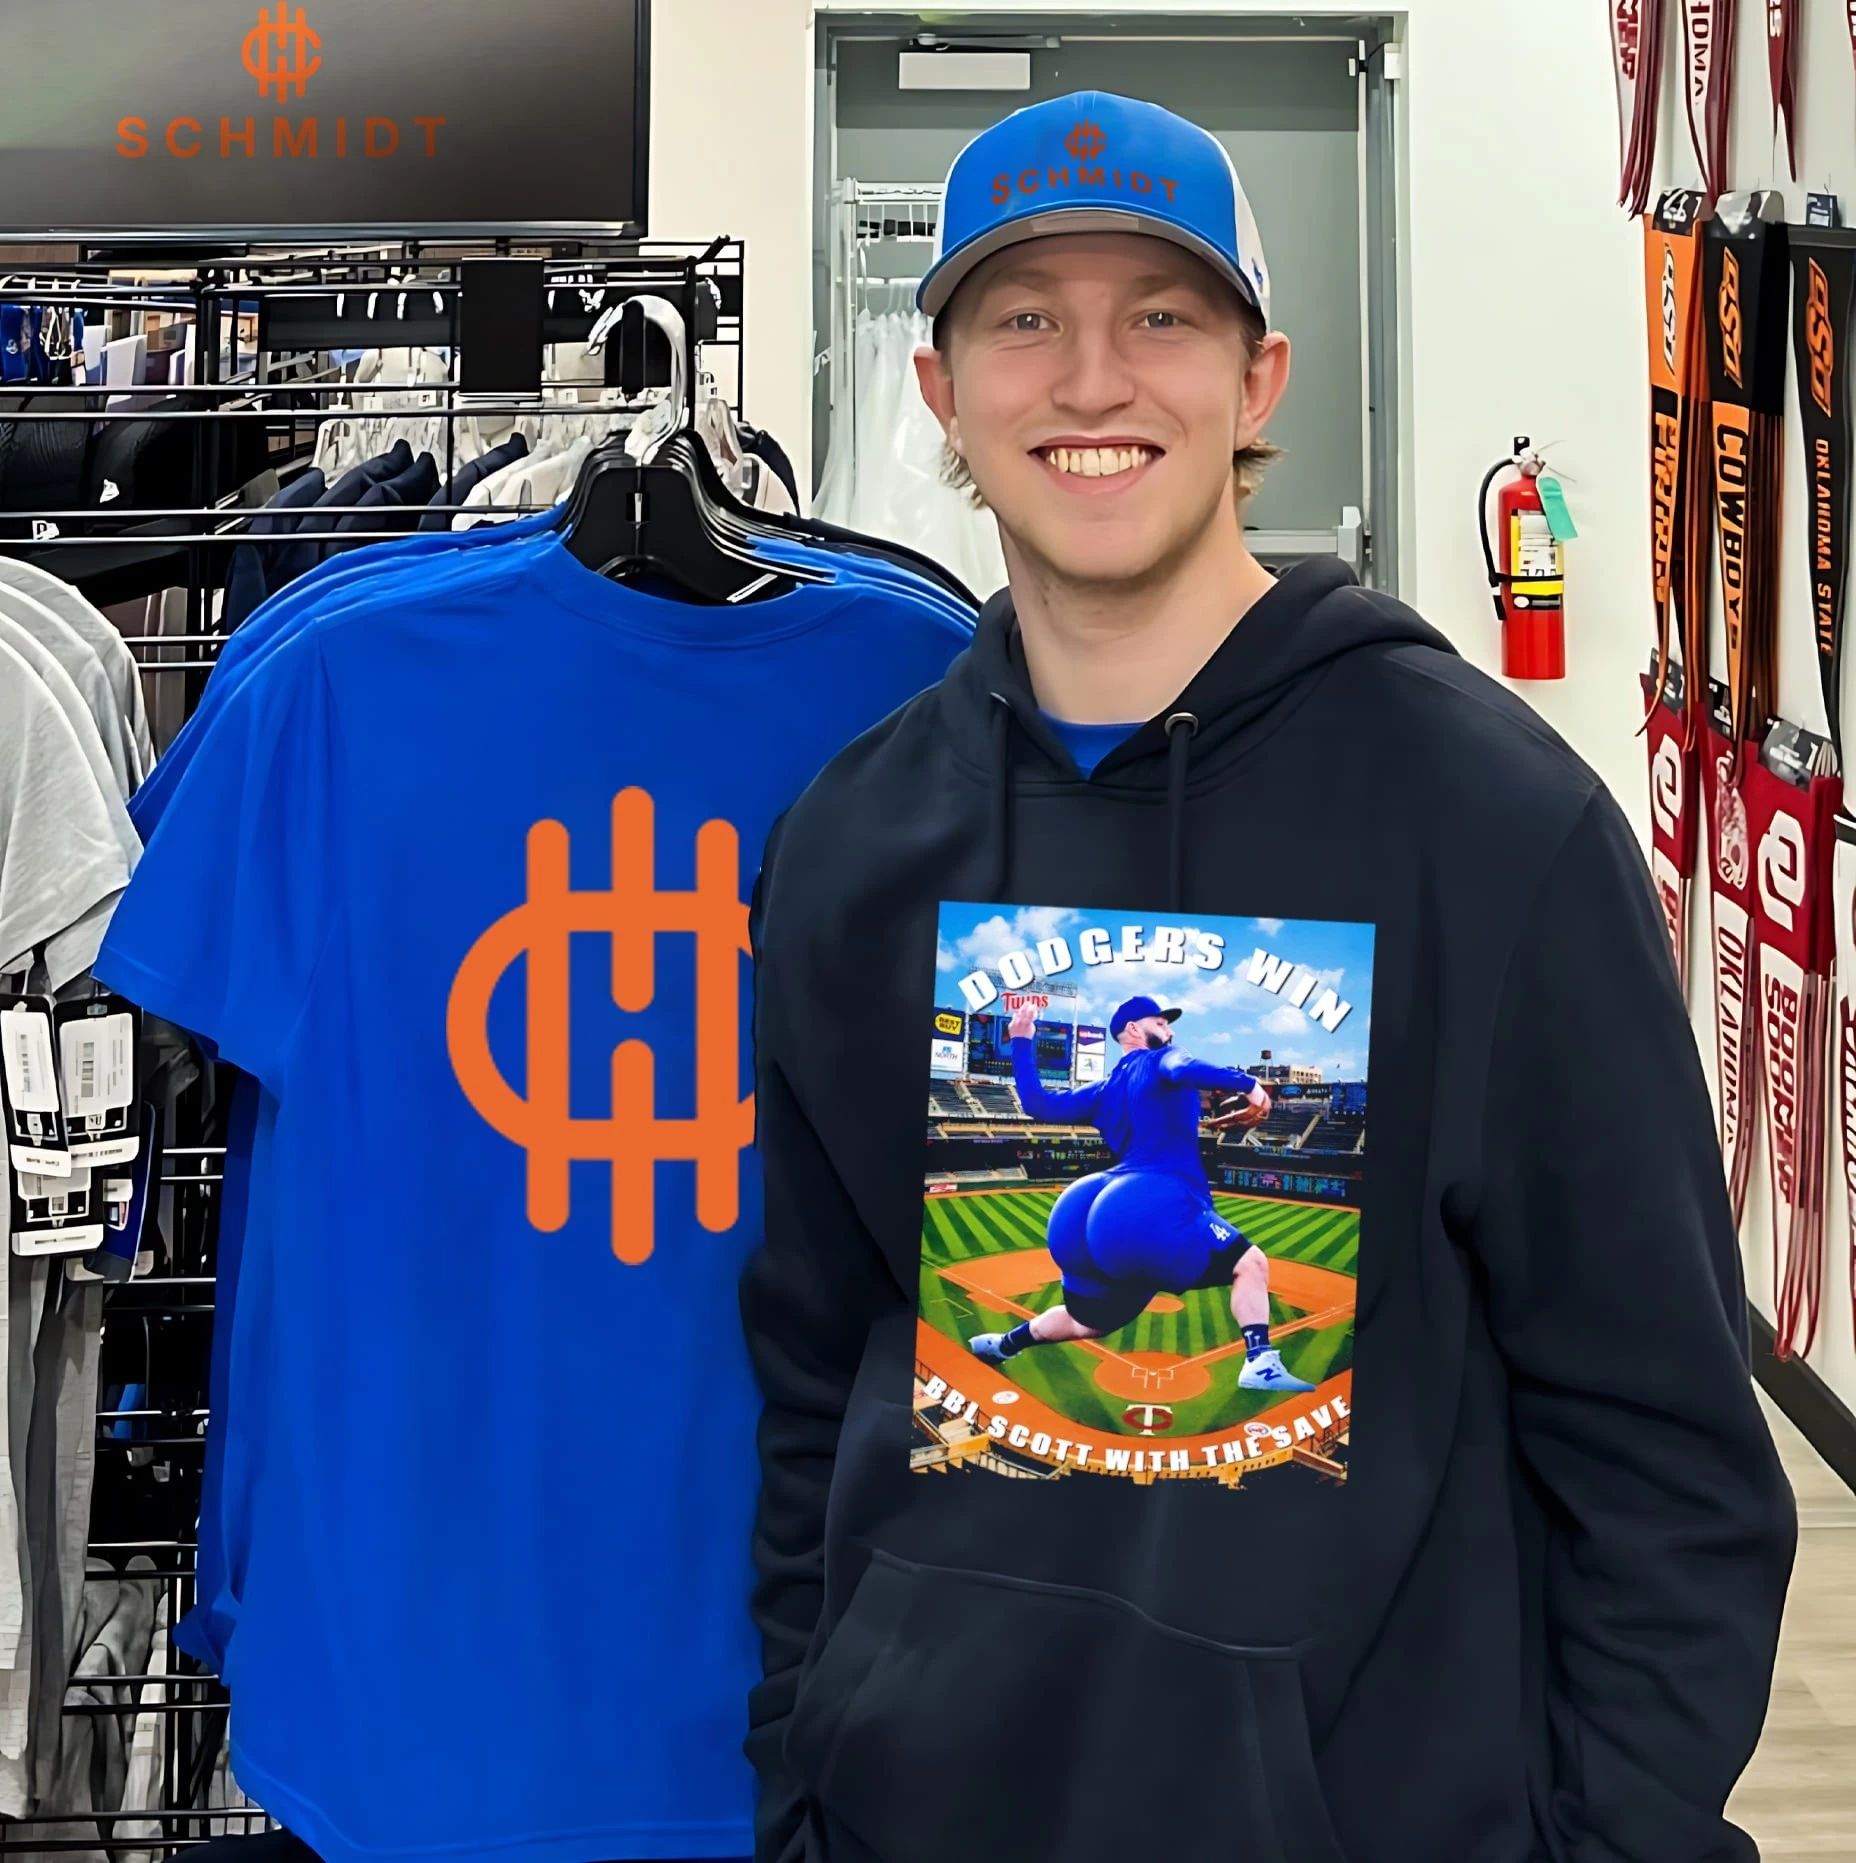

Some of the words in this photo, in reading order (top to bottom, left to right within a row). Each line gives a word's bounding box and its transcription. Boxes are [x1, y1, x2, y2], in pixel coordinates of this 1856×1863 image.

[115, 115, 449, 160] SCHMIDT
[991, 166, 1180, 204] SCHMIDT
[1817, 582, 1833, 657] STATE
[1245, 947, 1354, 1034] WIN
[923, 1375, 979, 1425] BBL
[987, 1414, 1094, 1467] SCOTT
[1104, 1448, 1191, 1473] WITH
[1201, 1436, 1261, 1467] THE
[1271, 1394, 1353, 1449] SAVE
